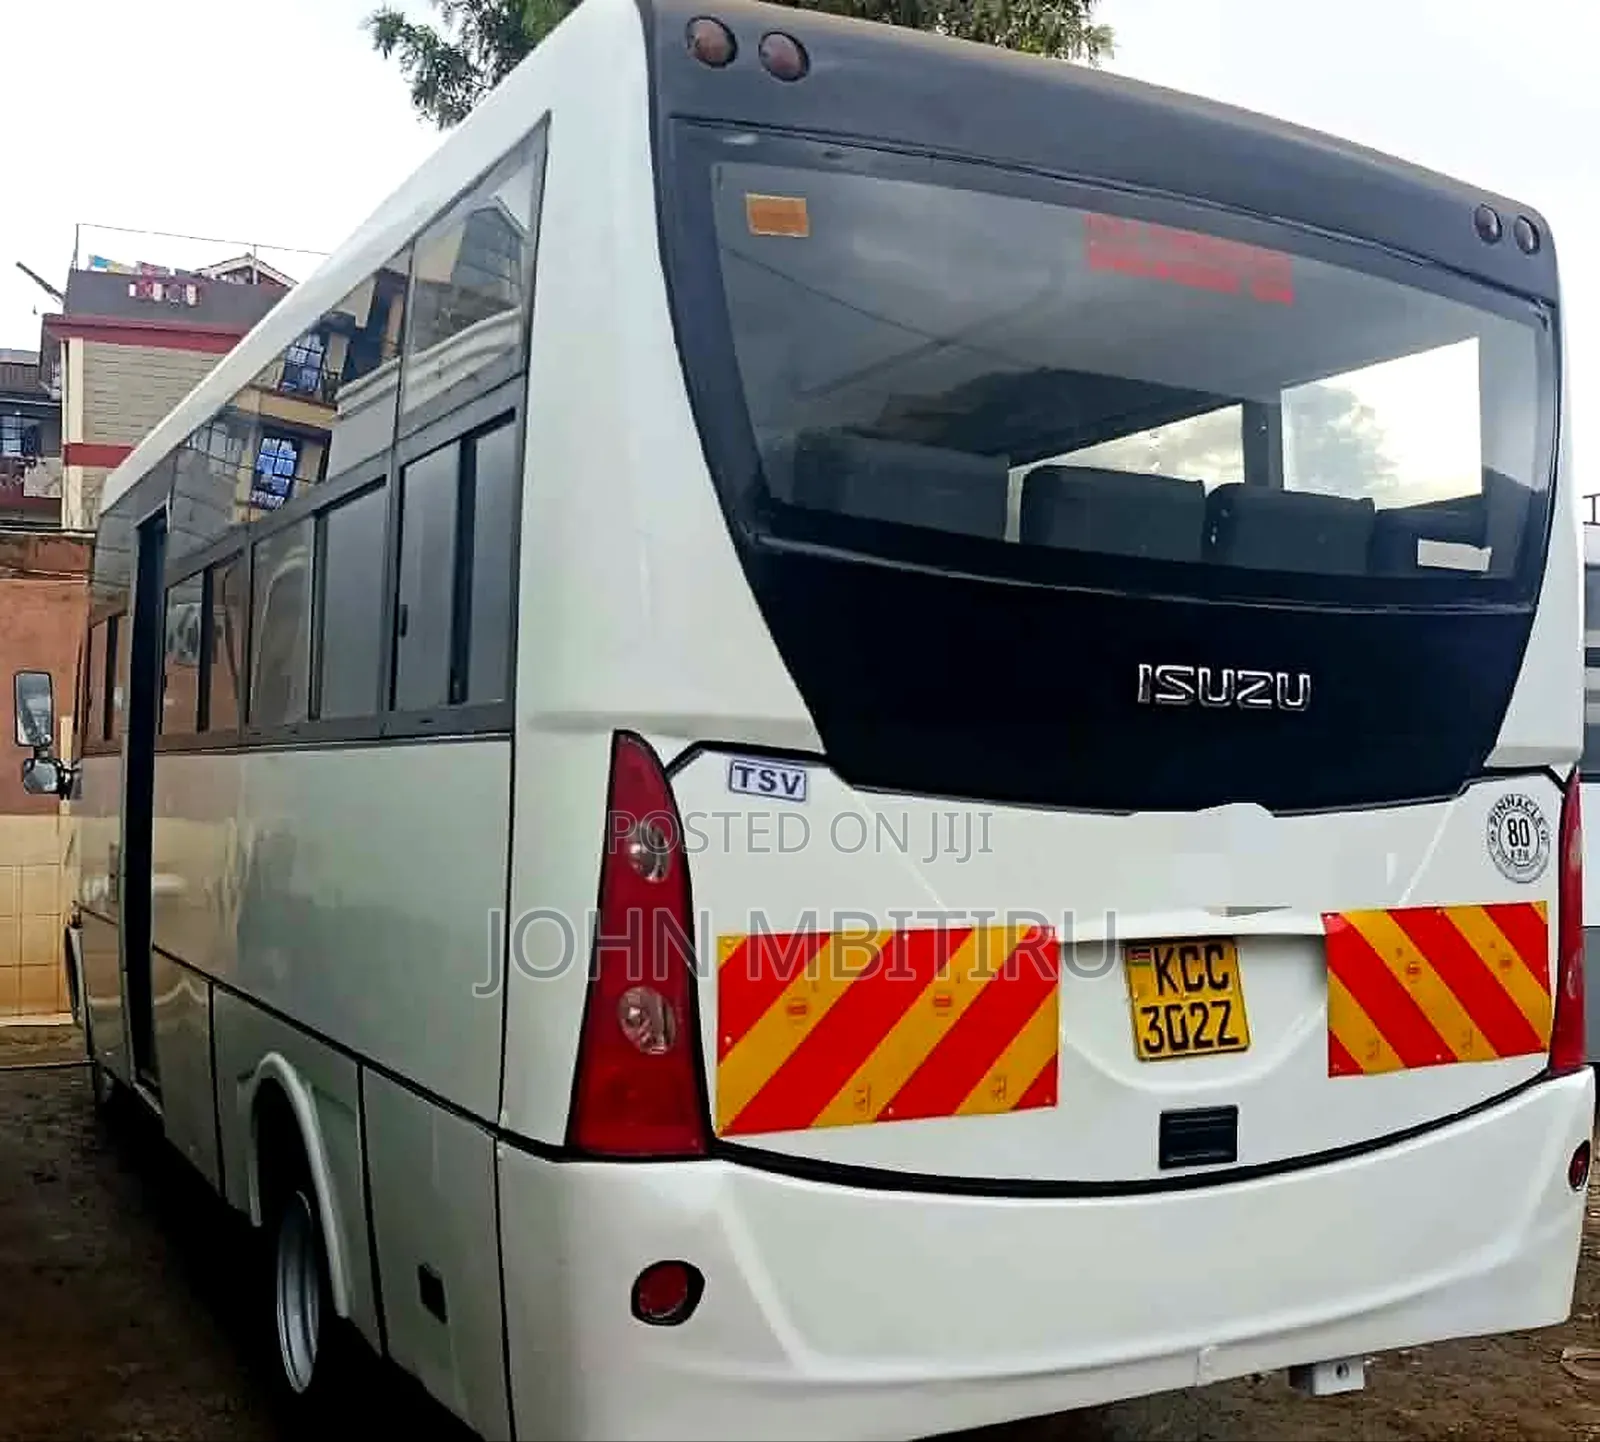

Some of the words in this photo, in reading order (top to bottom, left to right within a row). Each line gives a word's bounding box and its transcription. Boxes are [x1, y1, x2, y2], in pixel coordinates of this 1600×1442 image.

[1137, 664, 1311, 711] ISUZU
[734, 765, 801, 795] TSV
[1507, 818, 1530, 847] 80
[1152, 945, 1230, 996] KCC
[1140, 1000, 1240, 1053] 302Z
